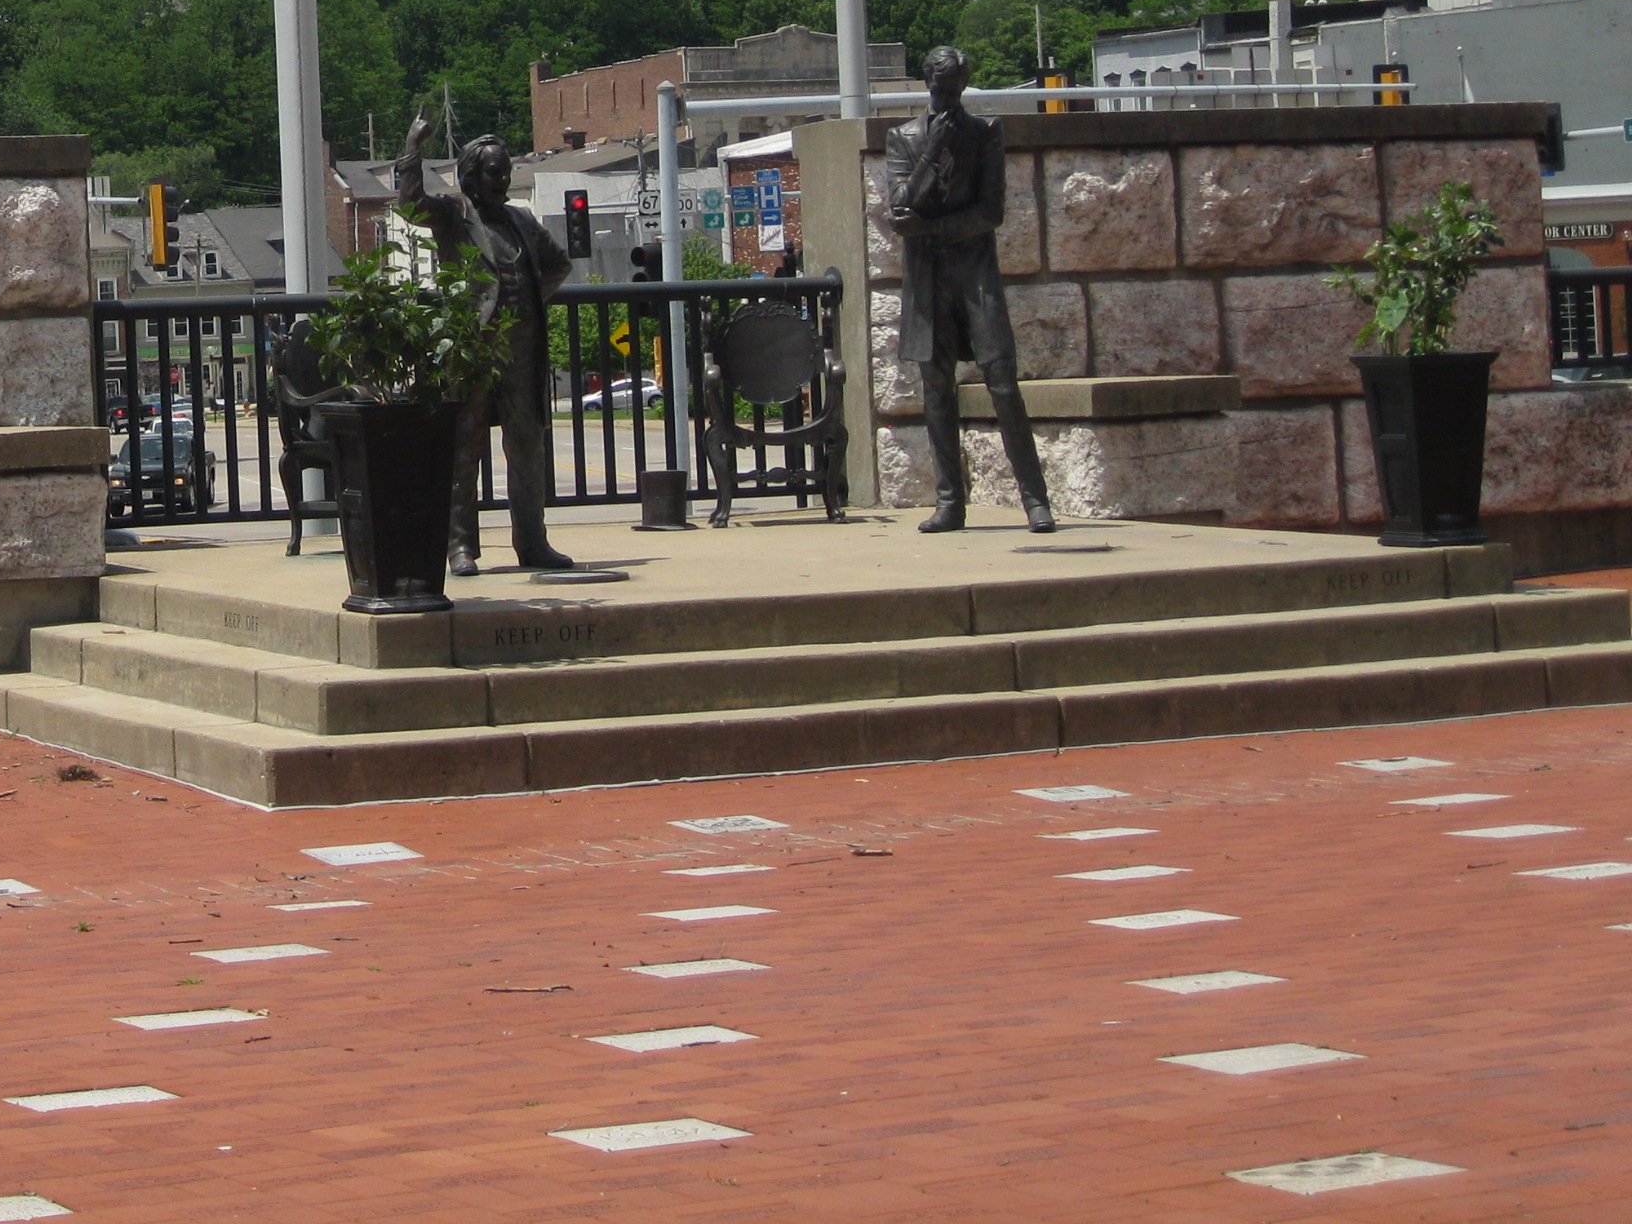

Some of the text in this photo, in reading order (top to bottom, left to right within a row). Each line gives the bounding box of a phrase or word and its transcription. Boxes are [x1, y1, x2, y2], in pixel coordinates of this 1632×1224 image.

[642, 196, 658, 210] 67
[760, 186, 779, 208] H
[1563, 224, 1608, 238] CENTER
[495, 623, 596, 645] KEEP OFF
